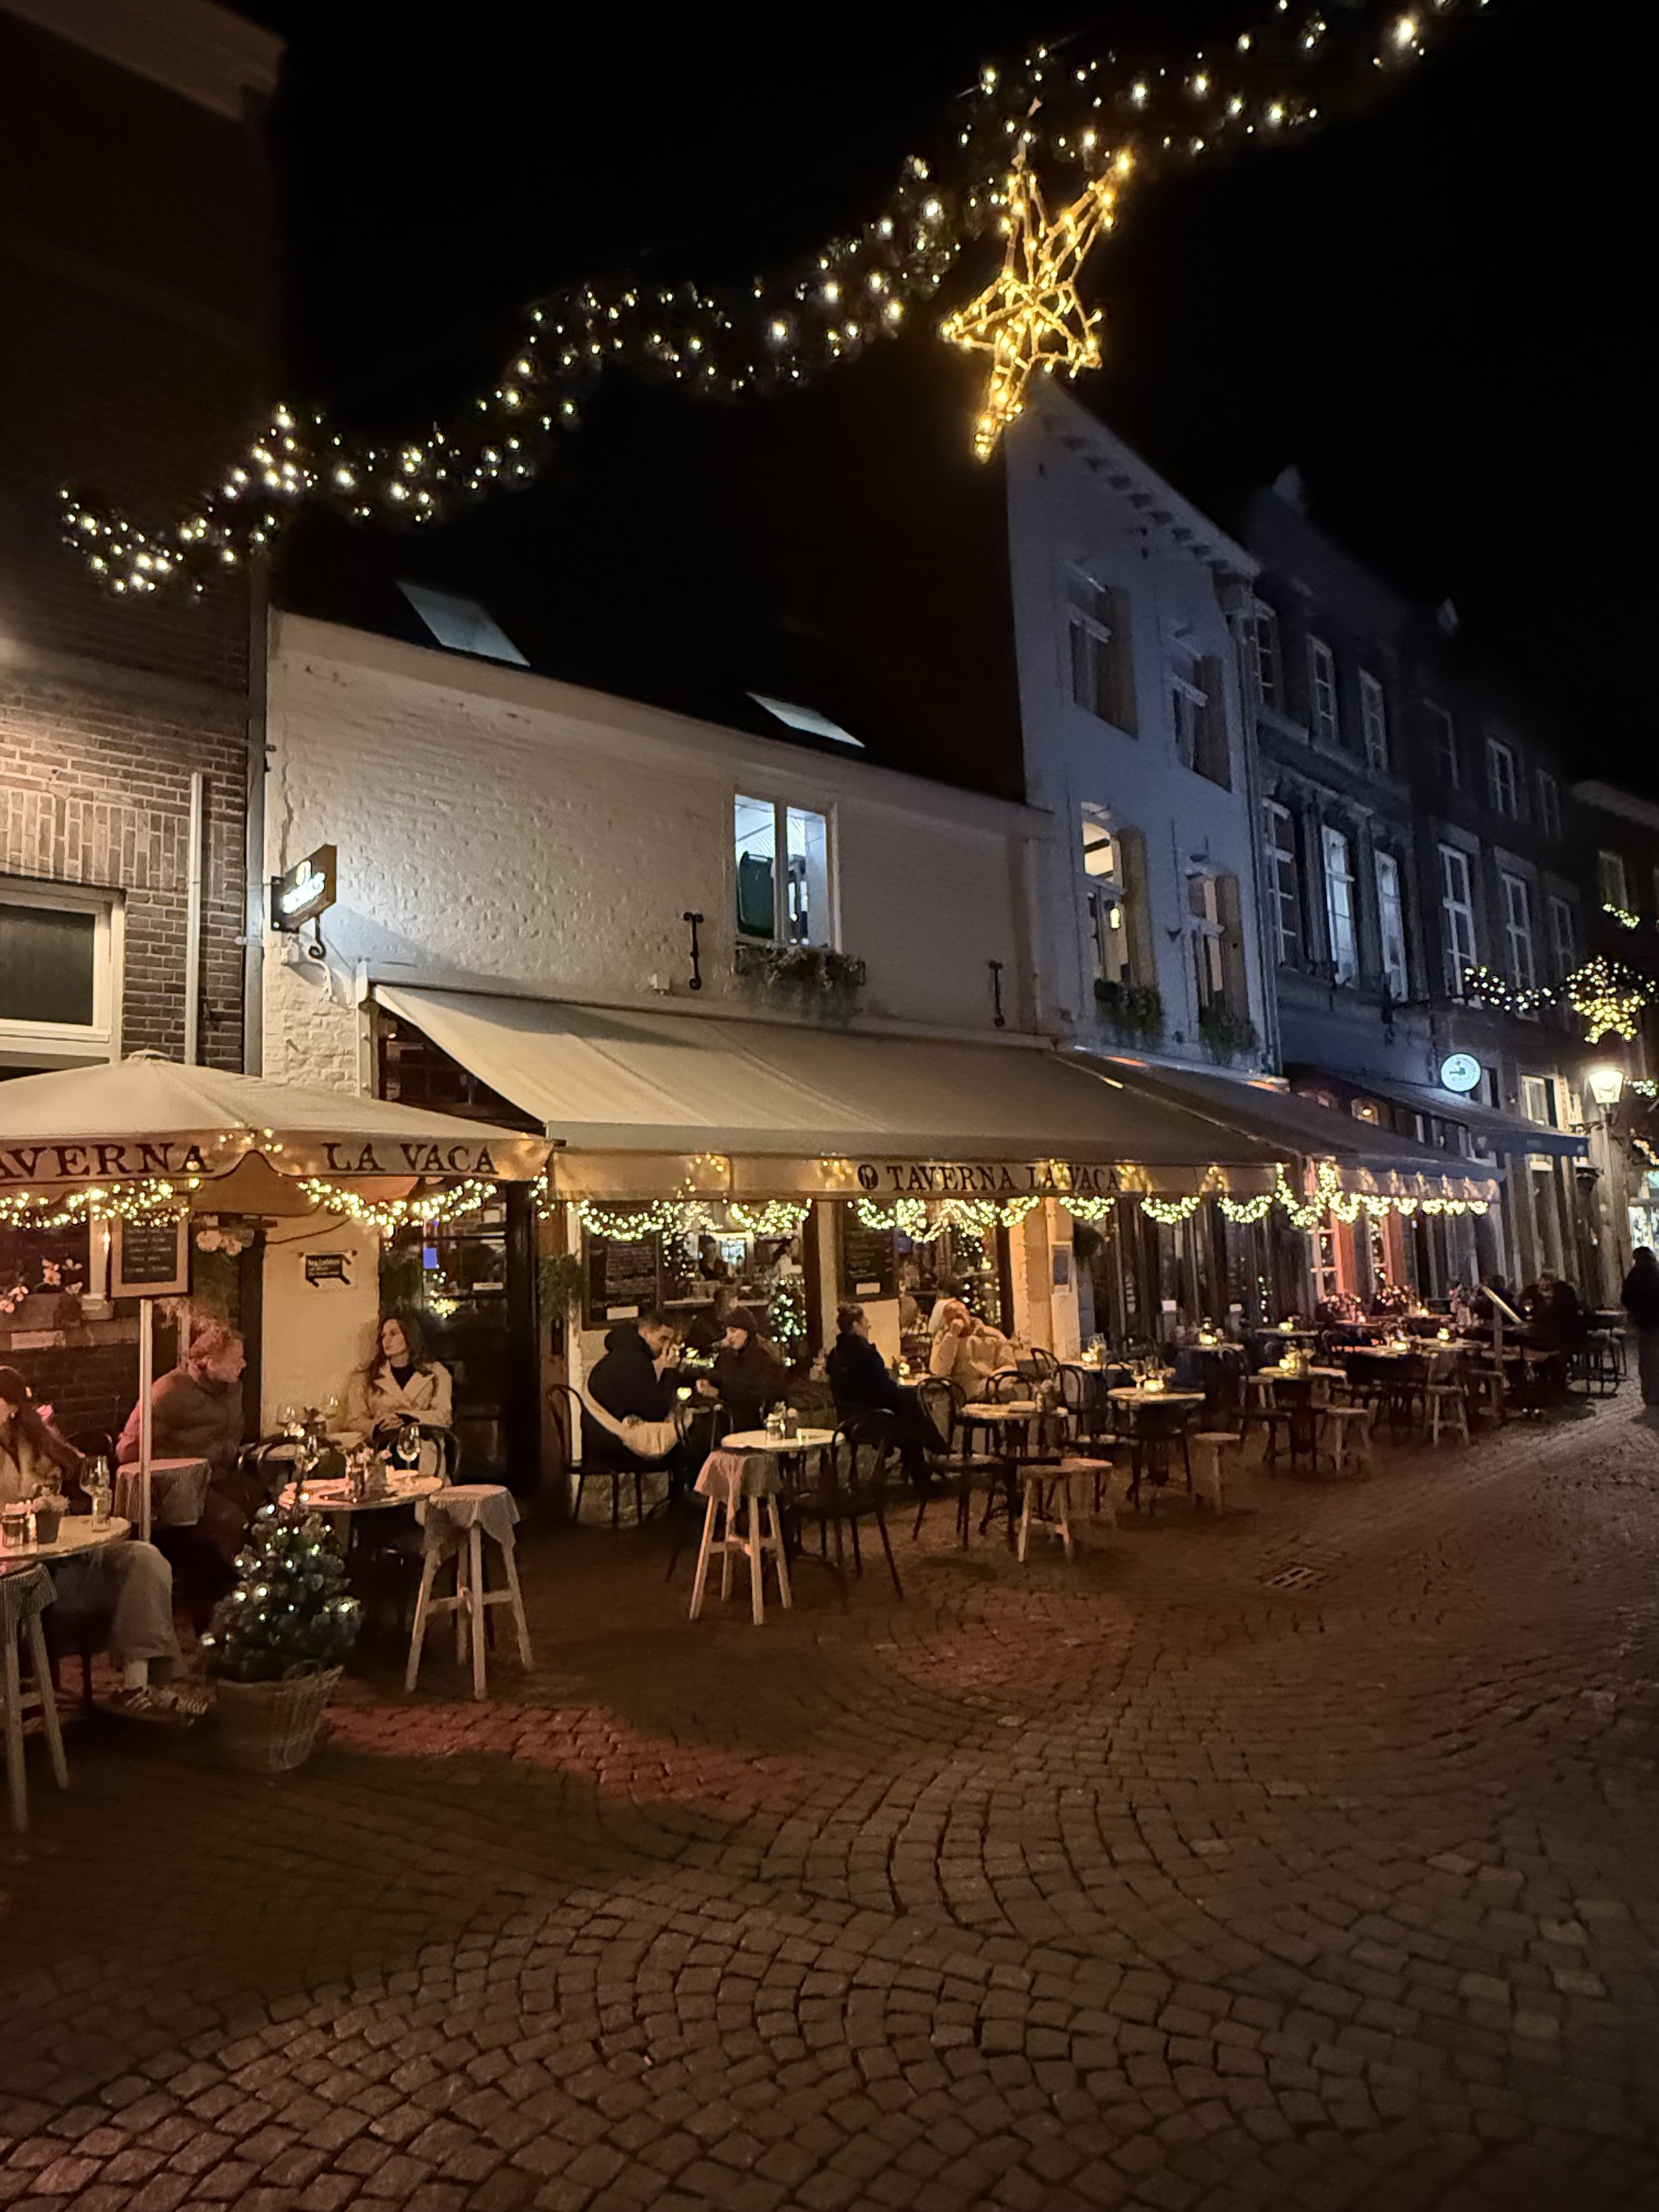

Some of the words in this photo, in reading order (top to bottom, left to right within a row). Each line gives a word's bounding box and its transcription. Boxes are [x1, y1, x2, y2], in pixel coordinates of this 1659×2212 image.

[321, 1142, 386, 1171] LA
[399, 1143, 500, 1175] VACA
[887, 1164, 1017, 1191] TAVERNA
[1026, 1165, 1058, 1189] LA
[1068, 1165, 1122, 1191] VACA
